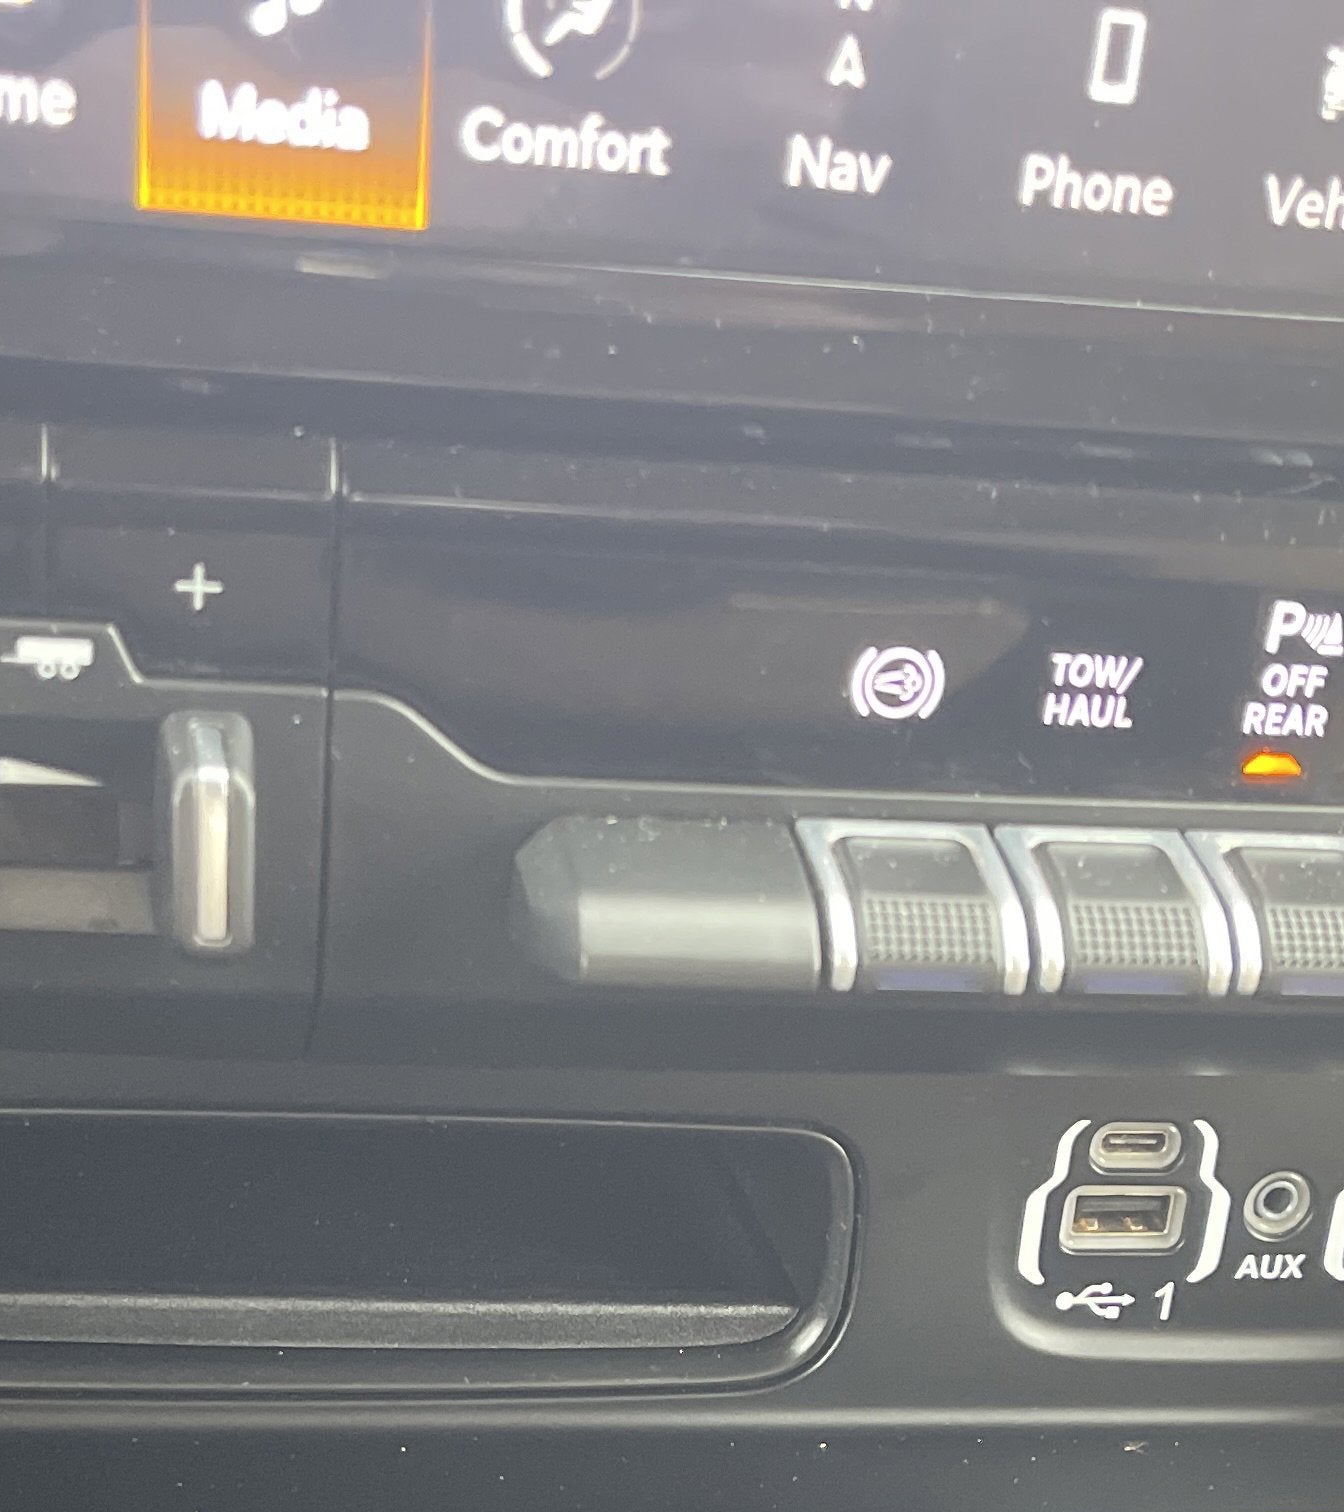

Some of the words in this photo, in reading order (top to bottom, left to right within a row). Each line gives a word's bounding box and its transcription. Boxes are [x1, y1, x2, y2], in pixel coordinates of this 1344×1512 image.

[198, 78, 371, 152] Media
[458, 104, 672, 177] Comfort
[783, 133, 893, 195] Nav
[1017, 152, 1174, 218] Phone
[1047, 651, 1144, 693] TOW/
[1259, 662, 1329, 700] OFF
[1041, 692, 1134, 729] HAUL
[1241, 702, 1329, 738] REAR
[1232, 1252, 1308, 1281] AUX
[1152, 1280, 1176, 1322] 1
